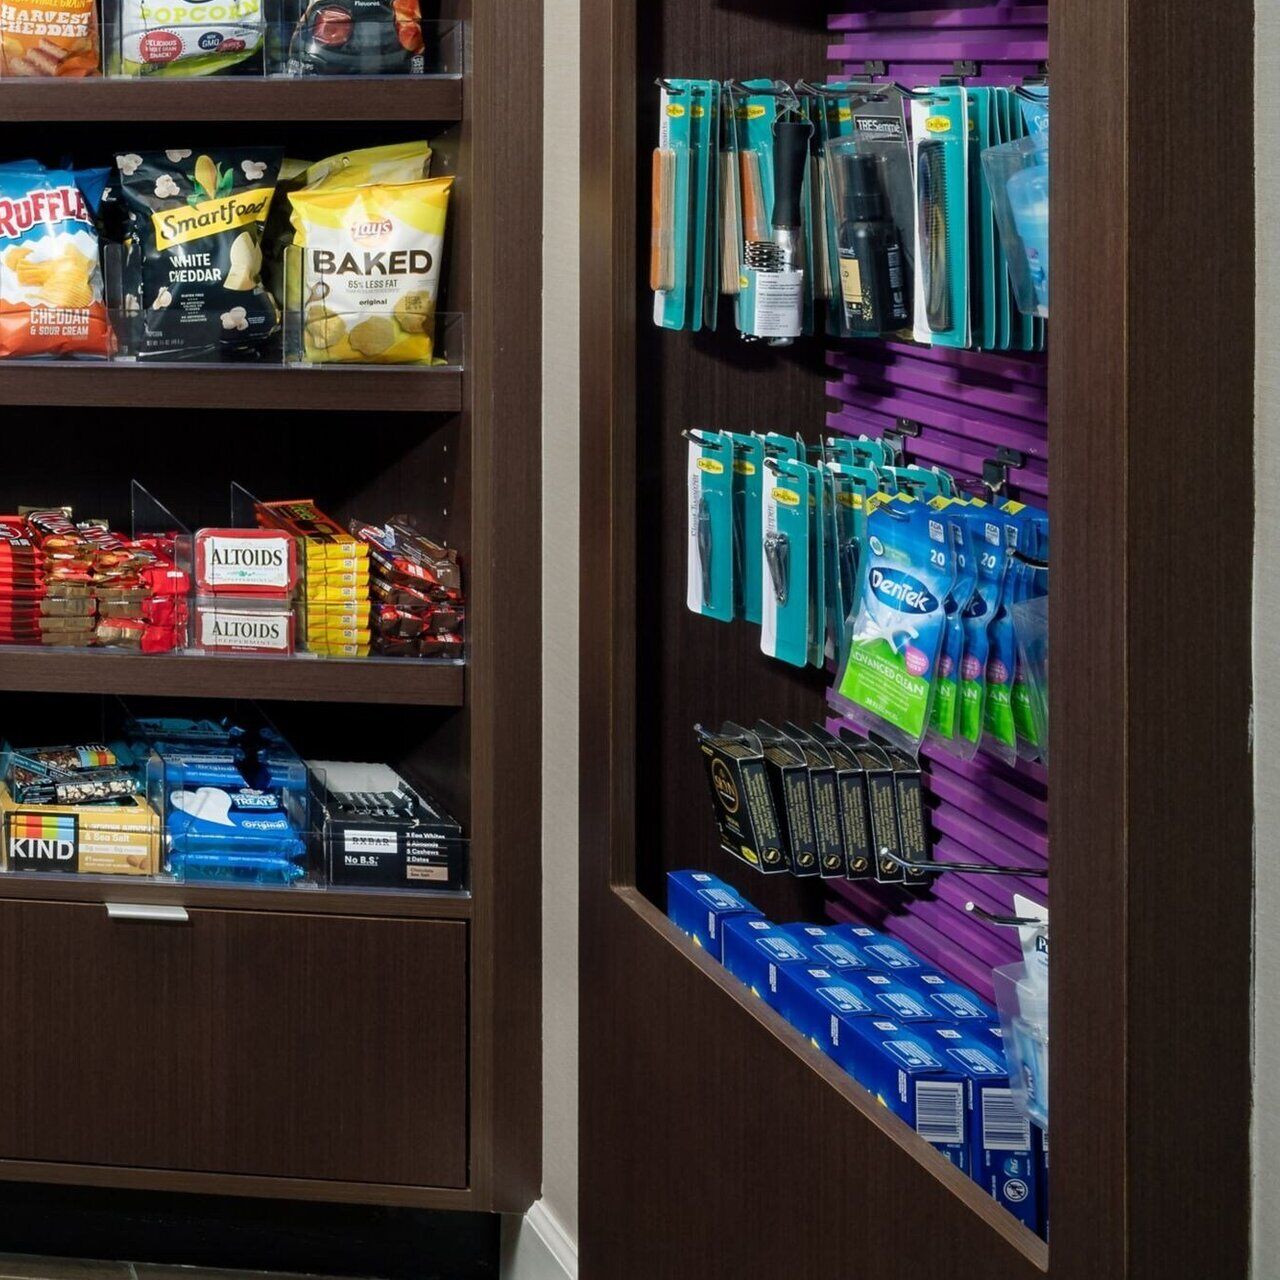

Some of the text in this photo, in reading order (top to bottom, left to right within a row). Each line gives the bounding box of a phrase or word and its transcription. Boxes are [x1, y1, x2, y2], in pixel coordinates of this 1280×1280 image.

[0, 4, 90, 25] HARVEST
[160, 198, 267, 240] Smartfood
[170, 254, 211, 268] WHITE
[313, 250, 433, 276] BAKED
[169, 268, 221, 282] CHEDDAR
[348, 279, 398, 289] 65% LESS FAT
[359, 298, 388, 307] original
[30, 308, 90, 324] CHEDDAR
[30, 326, 36, 335] &
[39, 326, 60, 335] SOUR
[62, 325, 89, 335] CREAM
[212, 548, 283, 567] ALTOIDS
[930, 549, 945, 566] 20
[981, 552, 996, 567] 20
[872, 570, 928, 611] DenTek
[212, 621, 280, 639] ALTOIDS
[850, 651, 896, 680] ADVANCED
[894, 671, 925, 697] CLEAN
[235, 798, 278, 808] TREATS
[241, 820, 287, 830] Original
[10, 838, 74, 859] KIND
[345, 856, 378, 864] No B.S.
